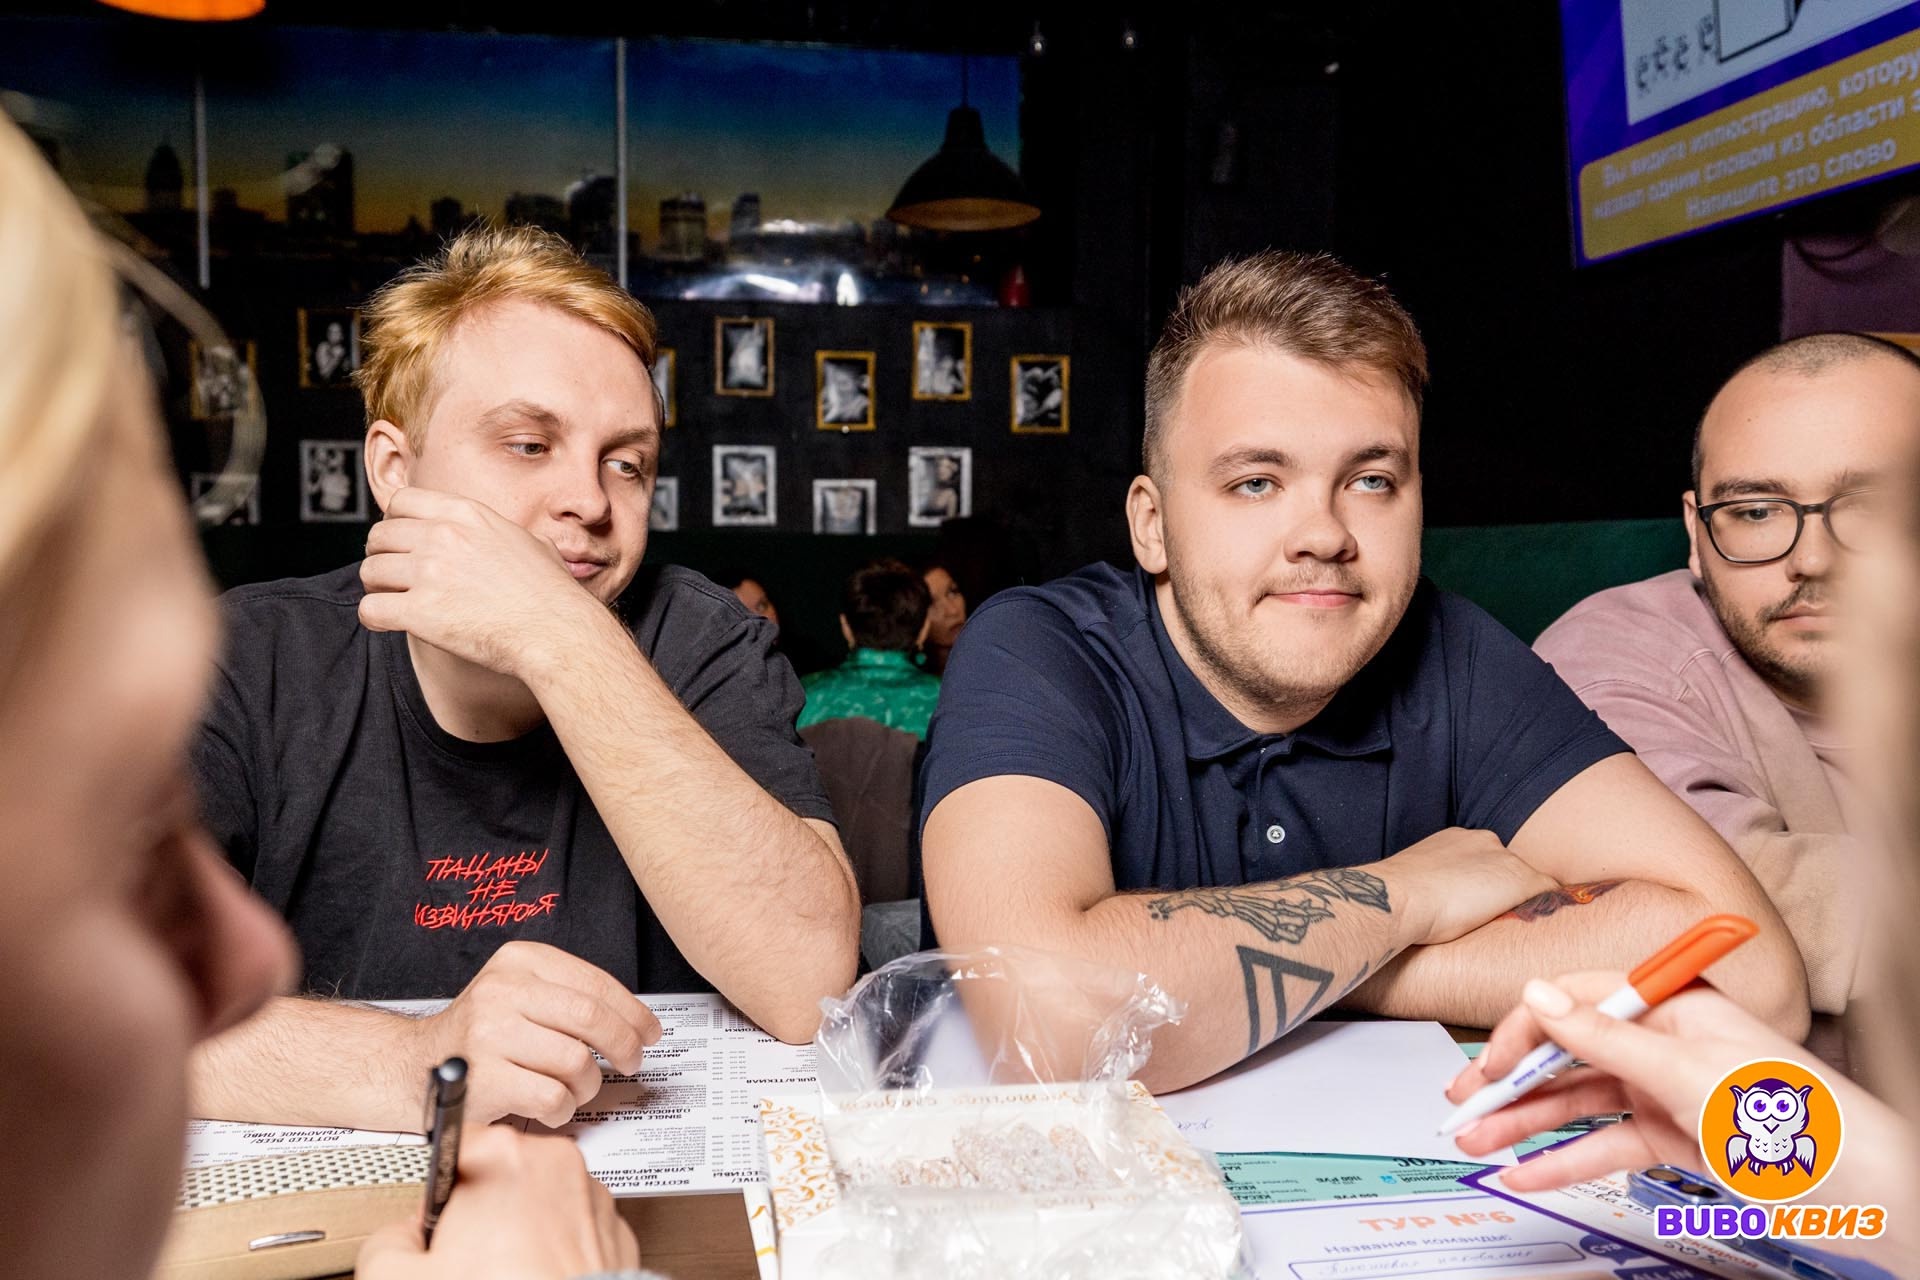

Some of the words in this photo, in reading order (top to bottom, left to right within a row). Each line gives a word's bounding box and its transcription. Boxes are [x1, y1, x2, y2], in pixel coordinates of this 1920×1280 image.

[1809, 97, 1904, 147] области
[1784, 163, 1820, 191] это
[1824, 139, 1896, 178] слово
[425, 848, 549, 884] ПАЦАНЫ
[467, 879, 519, 905] НЕ
[1358, 1216, 1437, 1233] ТУР
[1444, 1210, 1516, 1227] №6
[1323, 1240, 1417, 1254] Название
[1590, 1242, 1623, 1255] Ста
